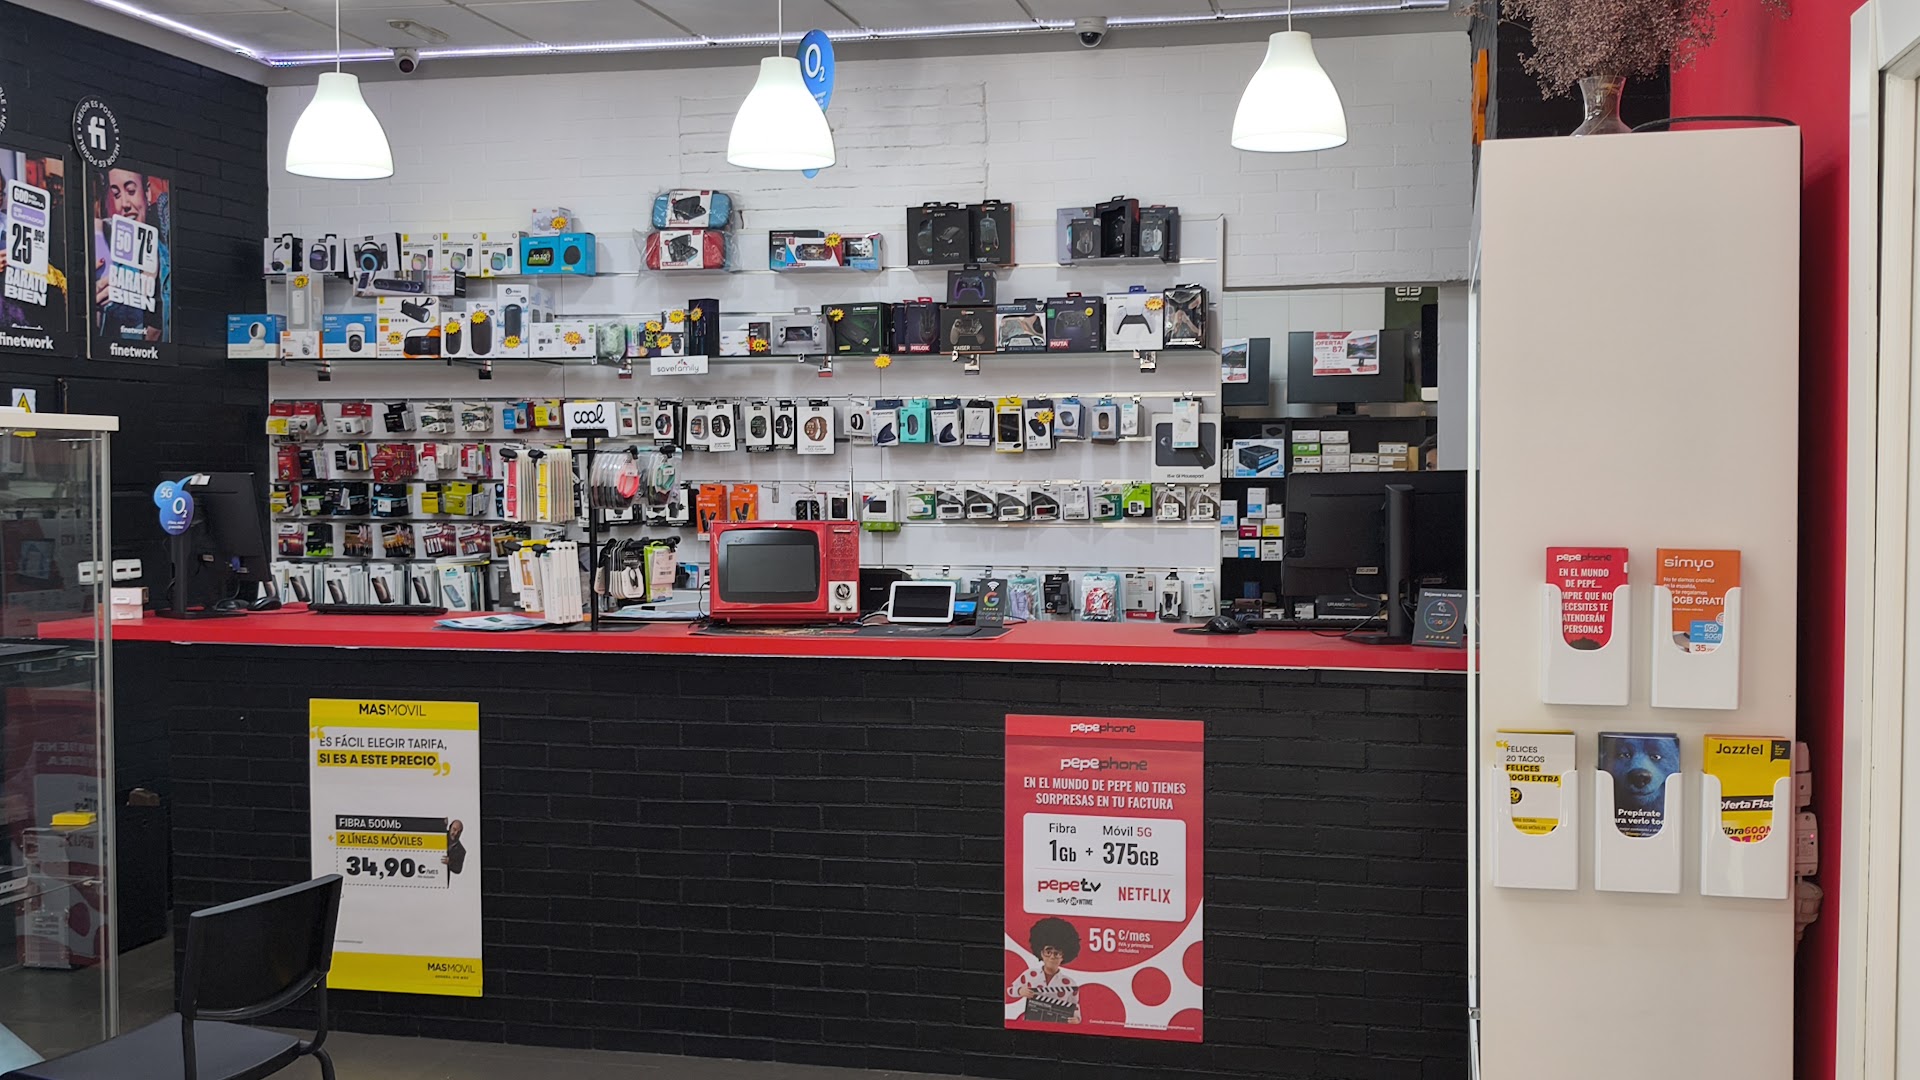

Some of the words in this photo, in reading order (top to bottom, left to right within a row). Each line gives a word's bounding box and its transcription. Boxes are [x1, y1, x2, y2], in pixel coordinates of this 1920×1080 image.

[805, 44, 825, 82] O2
[99, 103, 119, 134] POSIBLE
[88, 116, 107, 150] fi
[12, 223, 32, 264] 25
[5, 267, 48, 294] BARATO
[109, 264, 156, 298] BARATO
[4, 284, 46, 307] BIEN
[109, 286, 156, 313] BIEN
[120, 325, 148, 335] finetwork
[0, 332, 54, 350] finetwork
[110, 342, 159, 360] finetwork
[657, 363, 700, 374] savefamily
[573, 403, 606, 424] cool
[160, 487, 173, 499] 5G
[172, 496, 188, 518] O2
[1556, 553, 1612, 562] pepephone
[1664, 555, 1714, 572] simyo
[1559, 568, 1568, 576] EN
[1570, 568, 1579, 577] EL
[1581, 568, 1609, 577] MUNDO
[1565, 579, 1575, 588] DE
[1584, 592, 1600, 601] QUE
[1602, 592, 1613, 600] NO
[1599, 603, 1608, 611] TE
[1563, 612, 1605, 622] ATENDERÁN
[1564, 625, 1604, 634] PERSONAS
[1695, 644, 1707, 652] 35
[359, 703, 426, 717] MASMOVIL
[1070, 722, 1136, 734] pepephone
[319, 737, 332, 747] ES
[335, 735, 365, 747] FÁCIL
[368, 737, 405, 748] ELEGIR
[409, 738, 447, 750] TARIFA,
[1506, 745, 1538, 753] FELICES
[1716, 743, 1763, 755] Jazztel
[319, 753, 330, 763] SI
[333, 753, 347, 764] ES
[350, 754, 358, 764] A
[361, 755, 388, 765] ESTE
[391, 755, 436, 766] PRECIO
[1060, 756, 1148, 771] pepephone
[1506, 764, 1540, 772] FELICES
[1023, 776, 1036, 788] EN
[1038, 777, 1050, 789] EL
[1052, 778, 1089, 791] MUNDO
[1092, 779, 1105, 792] DE
[1107, 780, 1132, 793] PEPE
[1135, 781, 1149, 794] NO
[1152, 781, 1187, 795] TIENES
[1531, 775, 1559, 783] EXTRA
[1035, 792, 1095, 807] SORPRESAS
[1096, 795, 1109, 808] EN
[1111, 796, 1125, 808] TU
[1127, 797, 1174, 810] FACTURA
[1618, 809, 1661, 818] Prepárate
[340, 818, 366, 828] FIBRA
[368, 819, 402, 829] 500Mb
[1049, 822, 1077, 834] Fibra
[1102, 825, 1133, 837] Móvil
[1136, 826, 1152, 837] 5G
[340, 834, 346, 844] 2
[347, 832, 379, 844] LÍNEAS
[381, 833, 423, 846] MÓVILES
[1049, 839, 1077, 862] 1Gb
[1102, 841, 1159, 866] 375GB
[346, 855, 416, 879] 34,90
[1037, 878, 1102, 894] pepetv
[1118, 886, 1171, 904] NETFLIX
[1089, 927, 1116, 952] 56
[1118, 929, 1151, 942] €/mes
[427, 962, 476, 974] MASMOVIL
